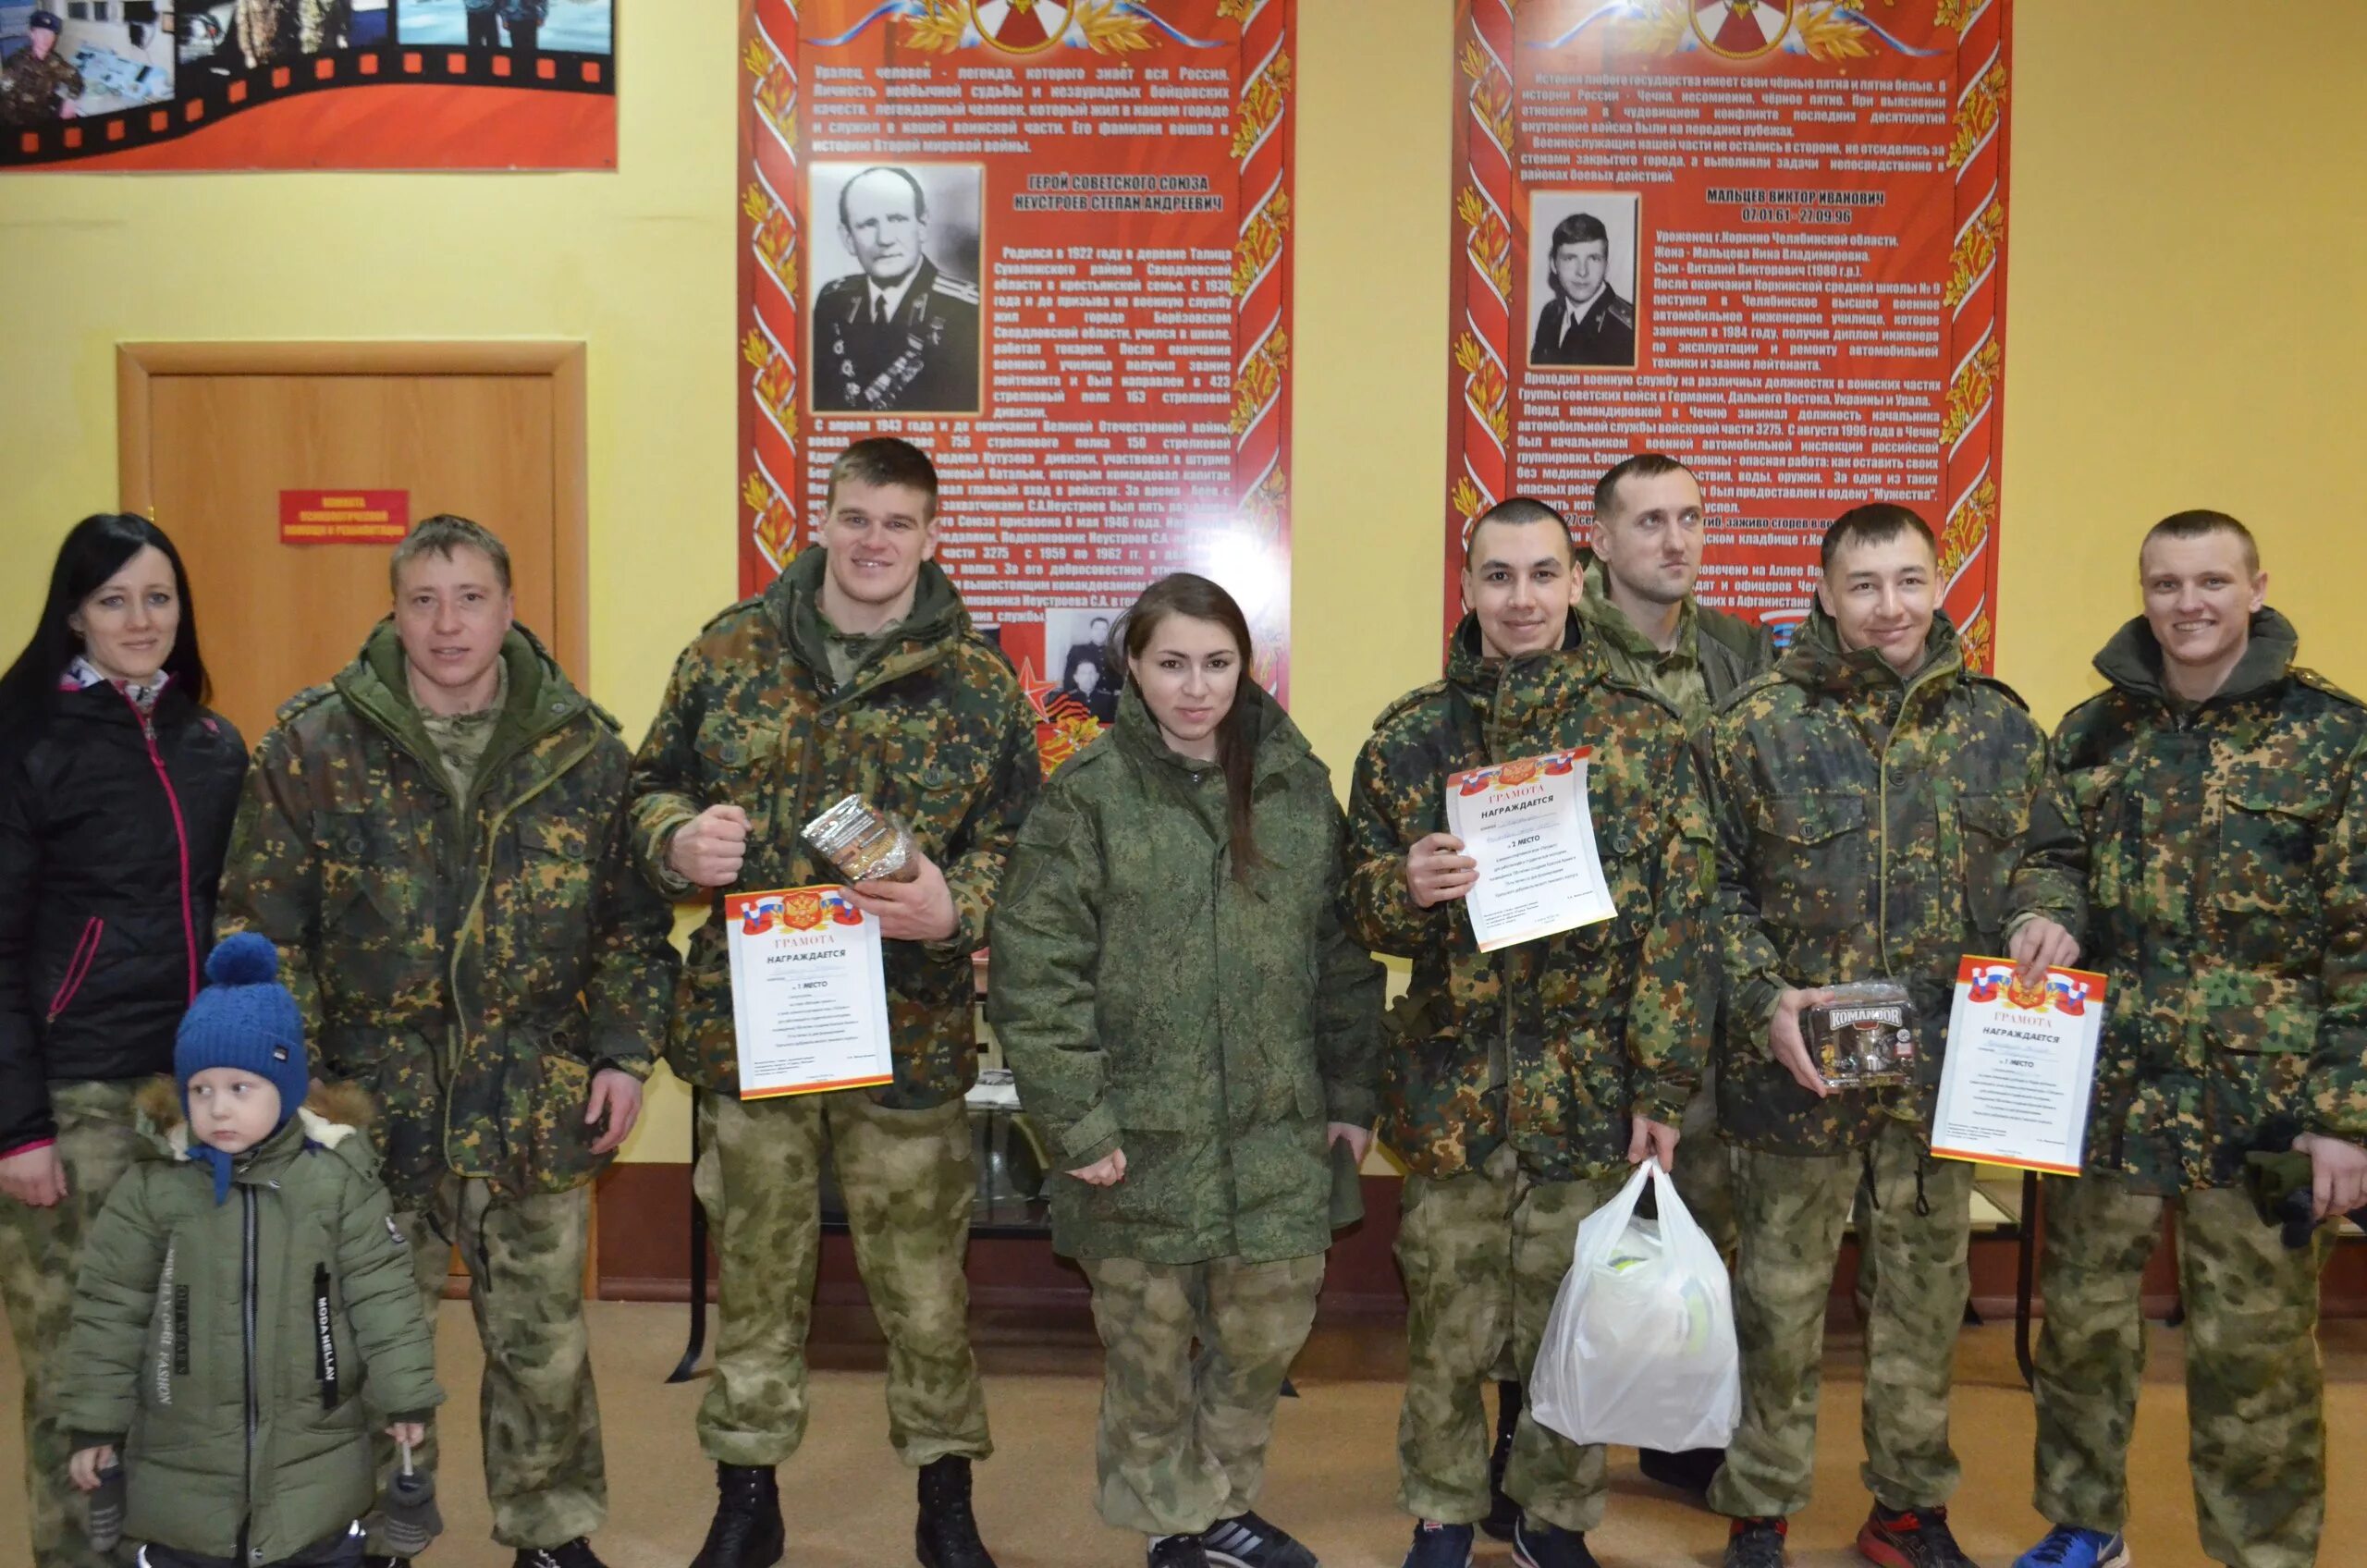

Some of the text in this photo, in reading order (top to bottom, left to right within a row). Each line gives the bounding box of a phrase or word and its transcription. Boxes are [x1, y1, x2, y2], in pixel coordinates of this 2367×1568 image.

[1028, 172, 1208, 191] ГЕРОЙ СОВЕТСКОГО СОЮЗА
[1013, 195, 1223, 212] НЕУСТРОЕВ СТЕПАН АНДРЕЕВИЧ
[1707, 189, 1884, 206] МАЛЬЦЕВ ВИКТОР ИВАНОВИЧ
[1653, 277, 1687, 289] После
[1690, 280, 1751, 290] окончания
[1754, 279, 1821, 291] Коркинской
[1825, 282, 1873, 293] средней
[1875, 283, 1917, 293] школы
[1919, 282, 1931, 293] №
[1653, 295, 1939, 310] поступил в Челябинское высшее военное
[1653, 310, 1742, 322] автомобильное
[1751, 312, 1821, 324] инженерное
[1894, 315, 1939, 325] которое
[1652, 326, 1707, 337] закончил
[1711, 327, 1718, 337] в
[1722, 325, 1747, 337] 1984
[1783, 328, 1829, 339] получив
[1833, 329, 1878, 340] диплом
[1882, 330, 1938, 341] инженера
[1652, 342, 1938, 357] по эксплуатации и ремонту автомобильной
[1651, 358, 1698, 368] техники
[1700, 359, 1707, 368] и
[1710, 359, 1749, 369] звание
[1524, 372, 1940, 390] Проходил военную службу на различных должностях в воинских частях
[1518, 388, 1560, 400] Группы
[1563, 390, 1620, 400] советских
[1623, 390, 1657, 401] войск
[1659, 392, 1665, 401] в
[1727, 391, 1782, 404] Дальнего
[1834, 393, 1883, 405] Украины
[1886, 396, 1893, 405] и
[1524, 404, 1939, 422] Перед командировкой в Чечню занимал должность начальника
[1517, 420, 1607, 432] автомобильной
[1610, 421, 1656, 434] службы
[1658, 423, 1719, 434] войсковой
[1721, 424, 1753, 434] части
[1788, 423, 1795, 435] С
[1797, 425, 1838, 436] августа
[1841, 424, 1867, 435] 1996
[1869, 427, 1894, 437] года
[1896, 427, 1903, 436] в
[1905, 426, 1940, 437] Чечне
[1517, 435, 1940, 453] был начальником военной автомобильной инспекции российской
[1710, 485, 1734, 496] был
[1735, 487, 1816, 498] предоставлен
[1818, 488, 1825, 497] к
[1827, 489, 1868, 500] ордену
[1726, 518, 1809, 530] заживо сгорев
[1735, 581, 1791, 592] офицеров
[1728, 595, 1810, 609] в Афганистане
[1487, 785, 1544, 803] ГРАМОТА
[1481, 795, 1553, 819] НАГРАЖДАЕТСЯ
[1518, 835, 1540, 846] МЕСТО
[774, 934, 836, 949] ГРАМОТА
[767, 949, 846, 964] НАГРАЖДАЕТСЯ
[803, 981, 828, 990] МЕСТО
[1993, 1011, 2053, 1029] ГРАМОТА
[1982, 1027, 2061, 1044] НАГРАЖДАЕТСЯ
[2010, 1060, 2034, 1068] МЕСТО
[318, 1297, 329, 1333] MODA
